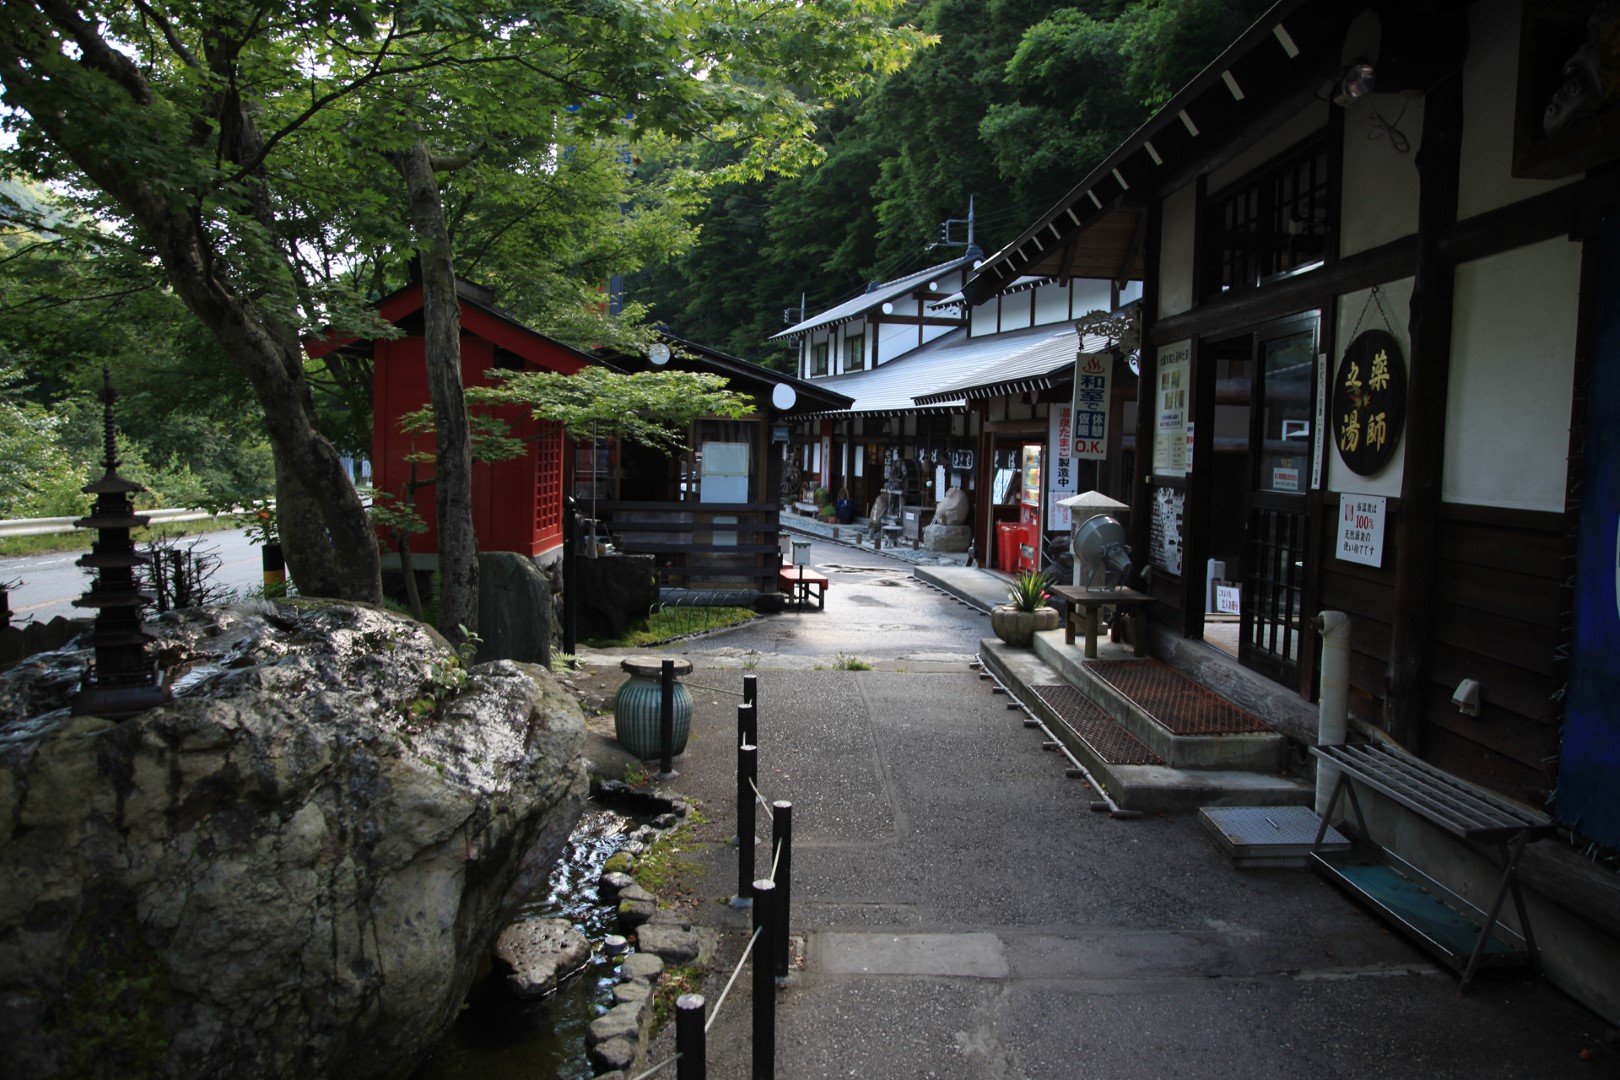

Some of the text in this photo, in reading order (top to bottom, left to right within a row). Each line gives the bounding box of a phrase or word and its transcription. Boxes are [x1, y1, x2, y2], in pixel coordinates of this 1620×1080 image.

[1080, 375, 1105, 410] 和室で
[1367, 349, 1390, 452] 薬師
[1077, 413, 1090, 437] 仮眠
[1091, 414, 1104, 437] 休憩
[1058, 407, 1070, 487] 温泉たまご製造中
[1075, 441, 1104, 454] O.K.
[1356, 515, 1374, 529] 100%
